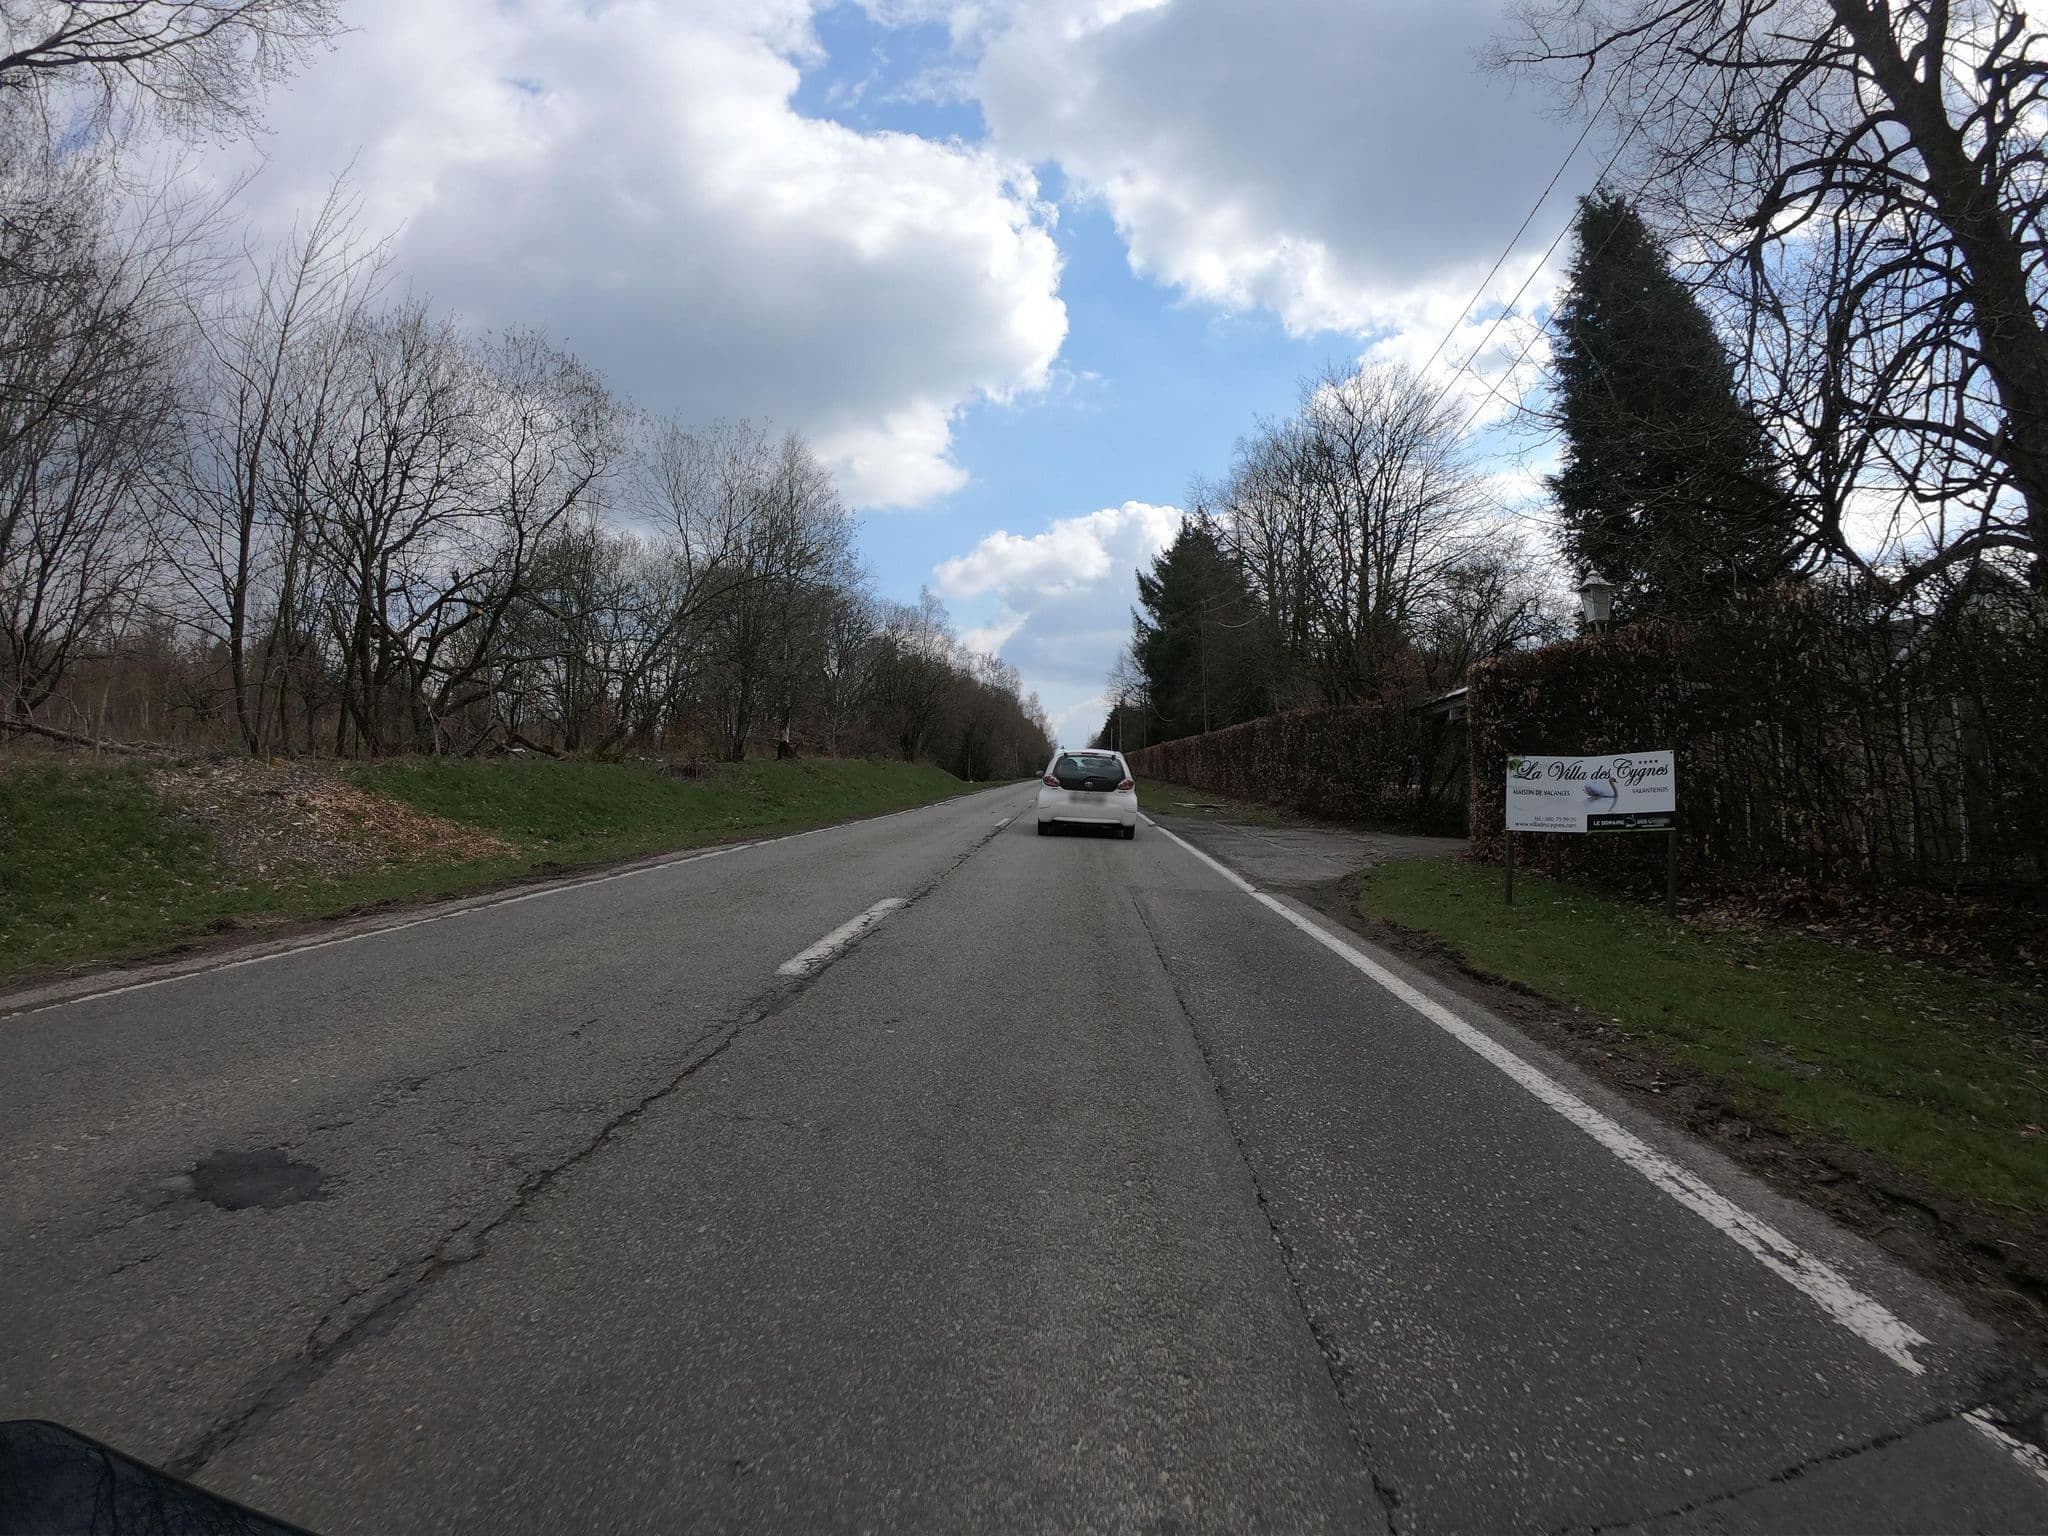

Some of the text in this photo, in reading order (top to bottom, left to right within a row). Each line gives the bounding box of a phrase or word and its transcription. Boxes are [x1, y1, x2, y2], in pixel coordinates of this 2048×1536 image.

[1513, 758, 1668, 786] La Villa des Cygnes
